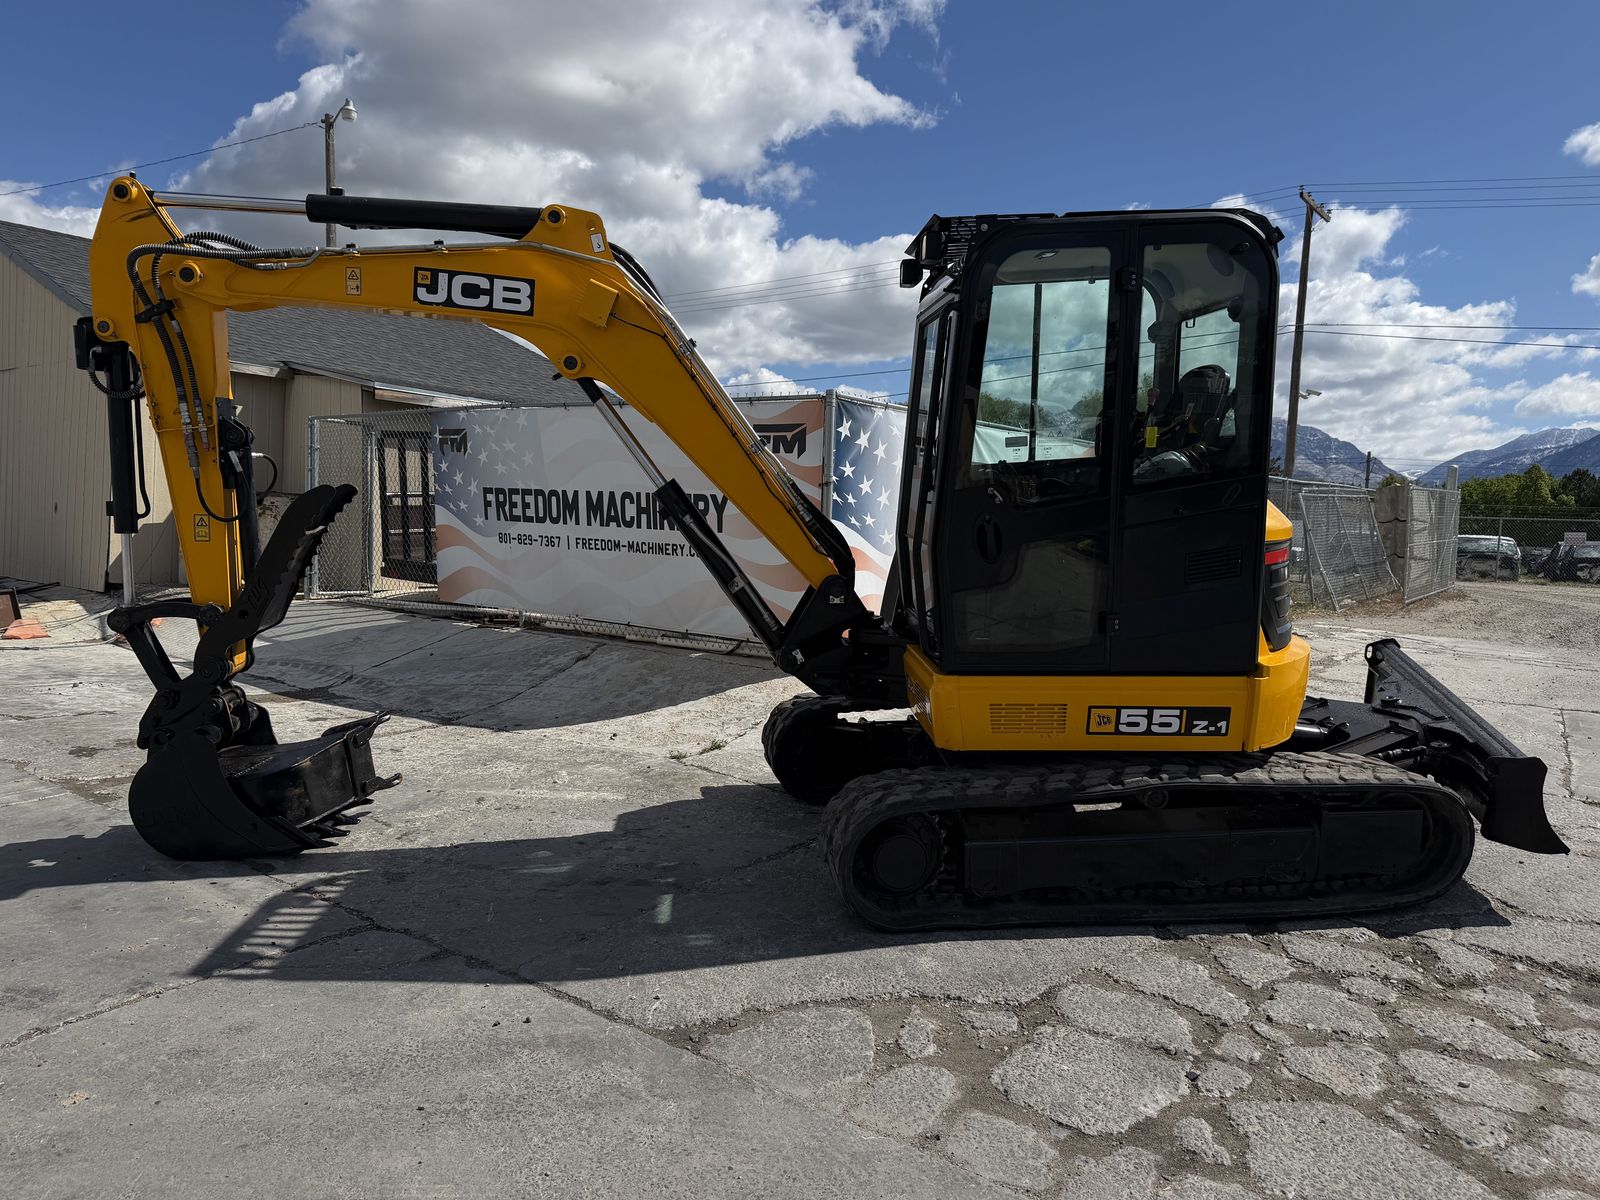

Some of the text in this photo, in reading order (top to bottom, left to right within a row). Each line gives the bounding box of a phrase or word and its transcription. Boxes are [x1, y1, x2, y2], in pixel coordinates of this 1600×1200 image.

[416, 272, 532, 312] JCB
[482, 486, 581, 526] FREEDOM
[498, 532, 562, 549] 801-829-7367
[1118, 708, 1227, 734] 55 Z-1
